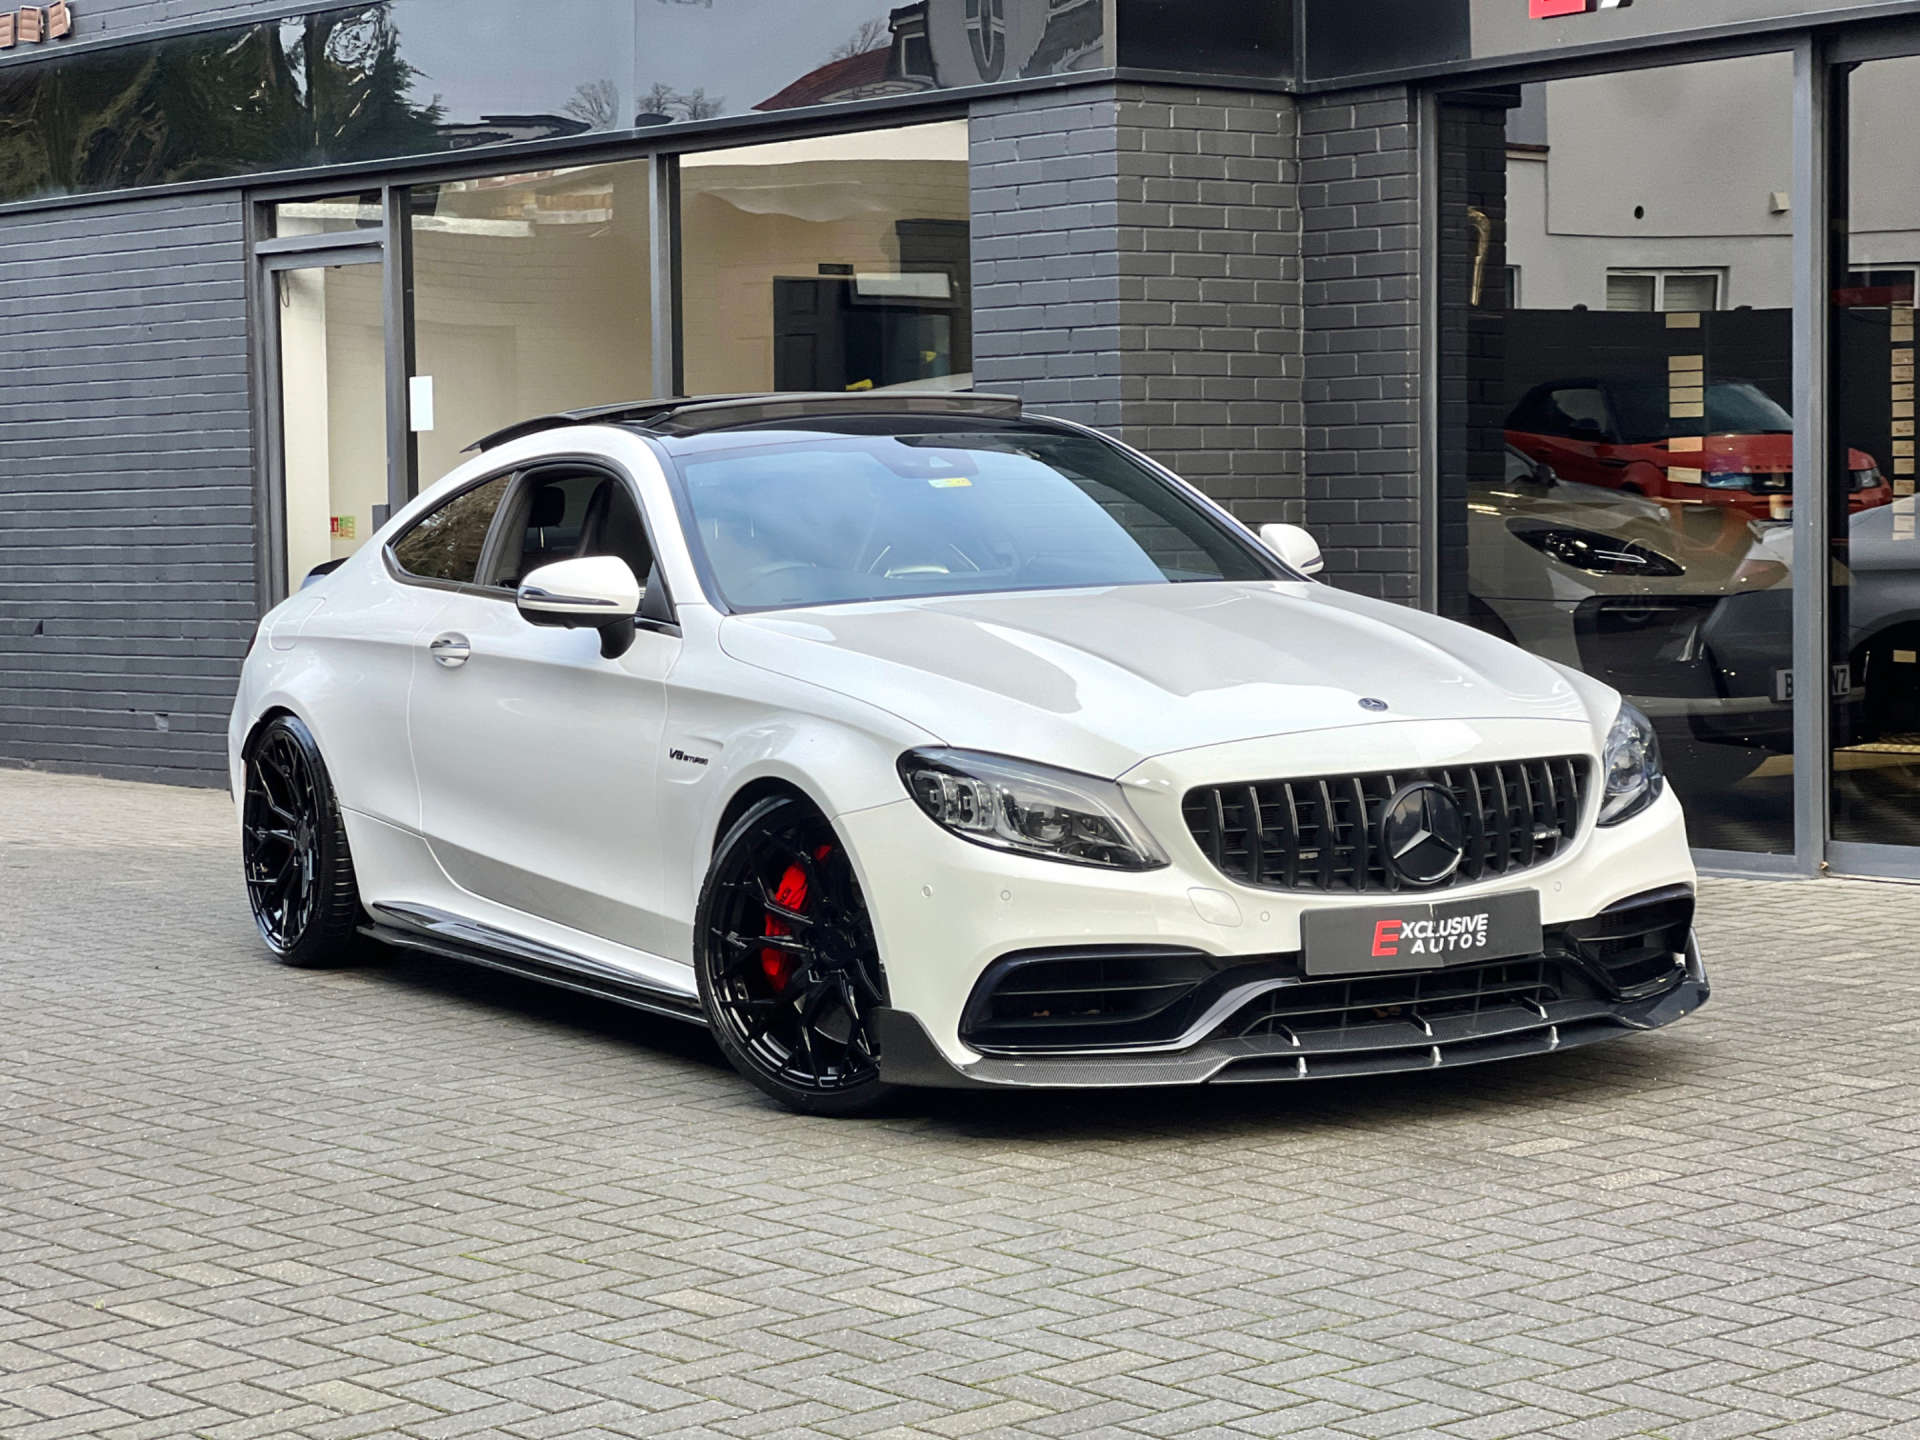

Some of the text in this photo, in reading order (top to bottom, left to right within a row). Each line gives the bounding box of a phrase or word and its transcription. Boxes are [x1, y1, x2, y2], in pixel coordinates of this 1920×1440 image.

[669, 748, 684, 760] V8
[1372, 913, 1488, 956] EXCLUSIVE
[1410, 932, 1486, 954] AUTOS
